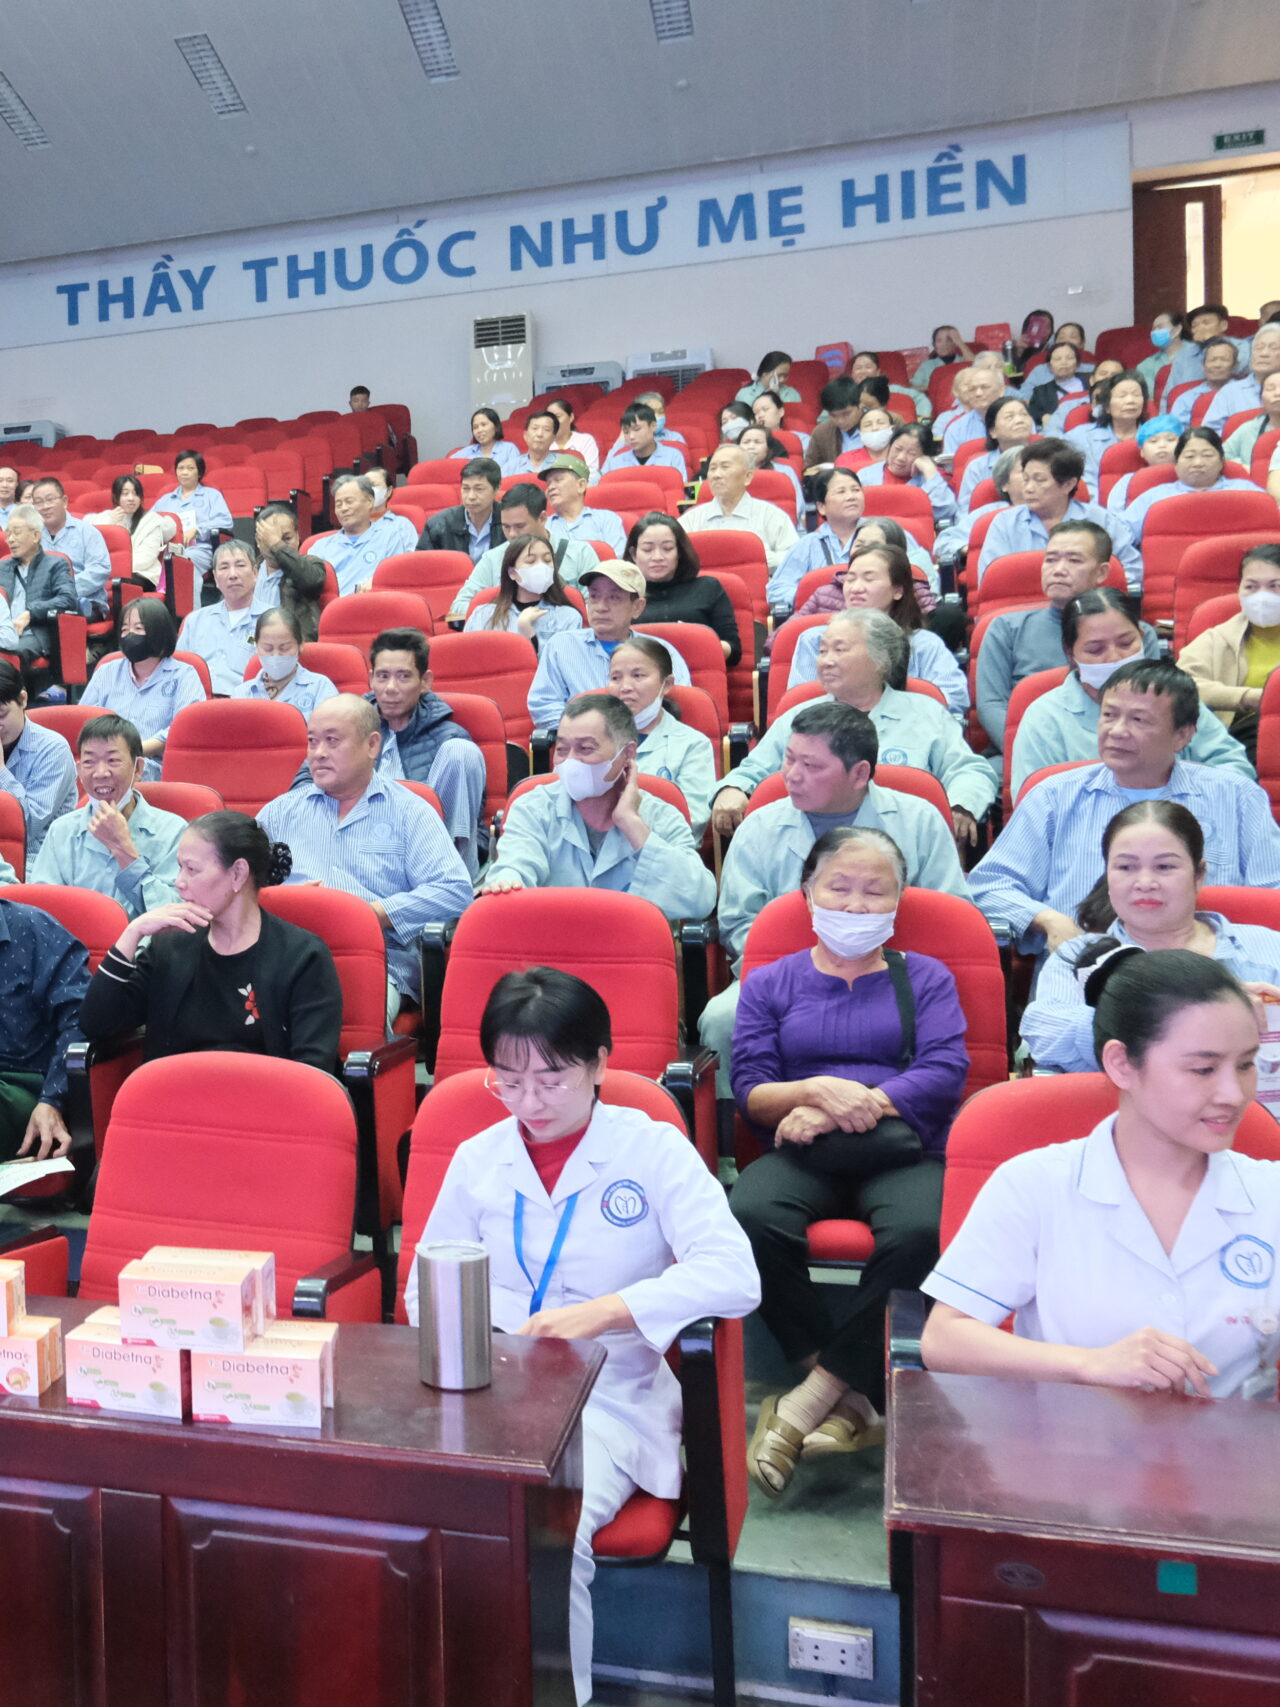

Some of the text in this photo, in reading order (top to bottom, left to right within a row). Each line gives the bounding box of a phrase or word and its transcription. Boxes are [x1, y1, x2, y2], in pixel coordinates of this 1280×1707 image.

[56, 144, 1028, 326] THẦY THUỐC NHƯ MẸ HIỀN
[147, 1285, 213, 1301] Diabetna
[92, 1346, 152, 1365] Diabetna
[221, 1359, 290, 1376] Diabetna
